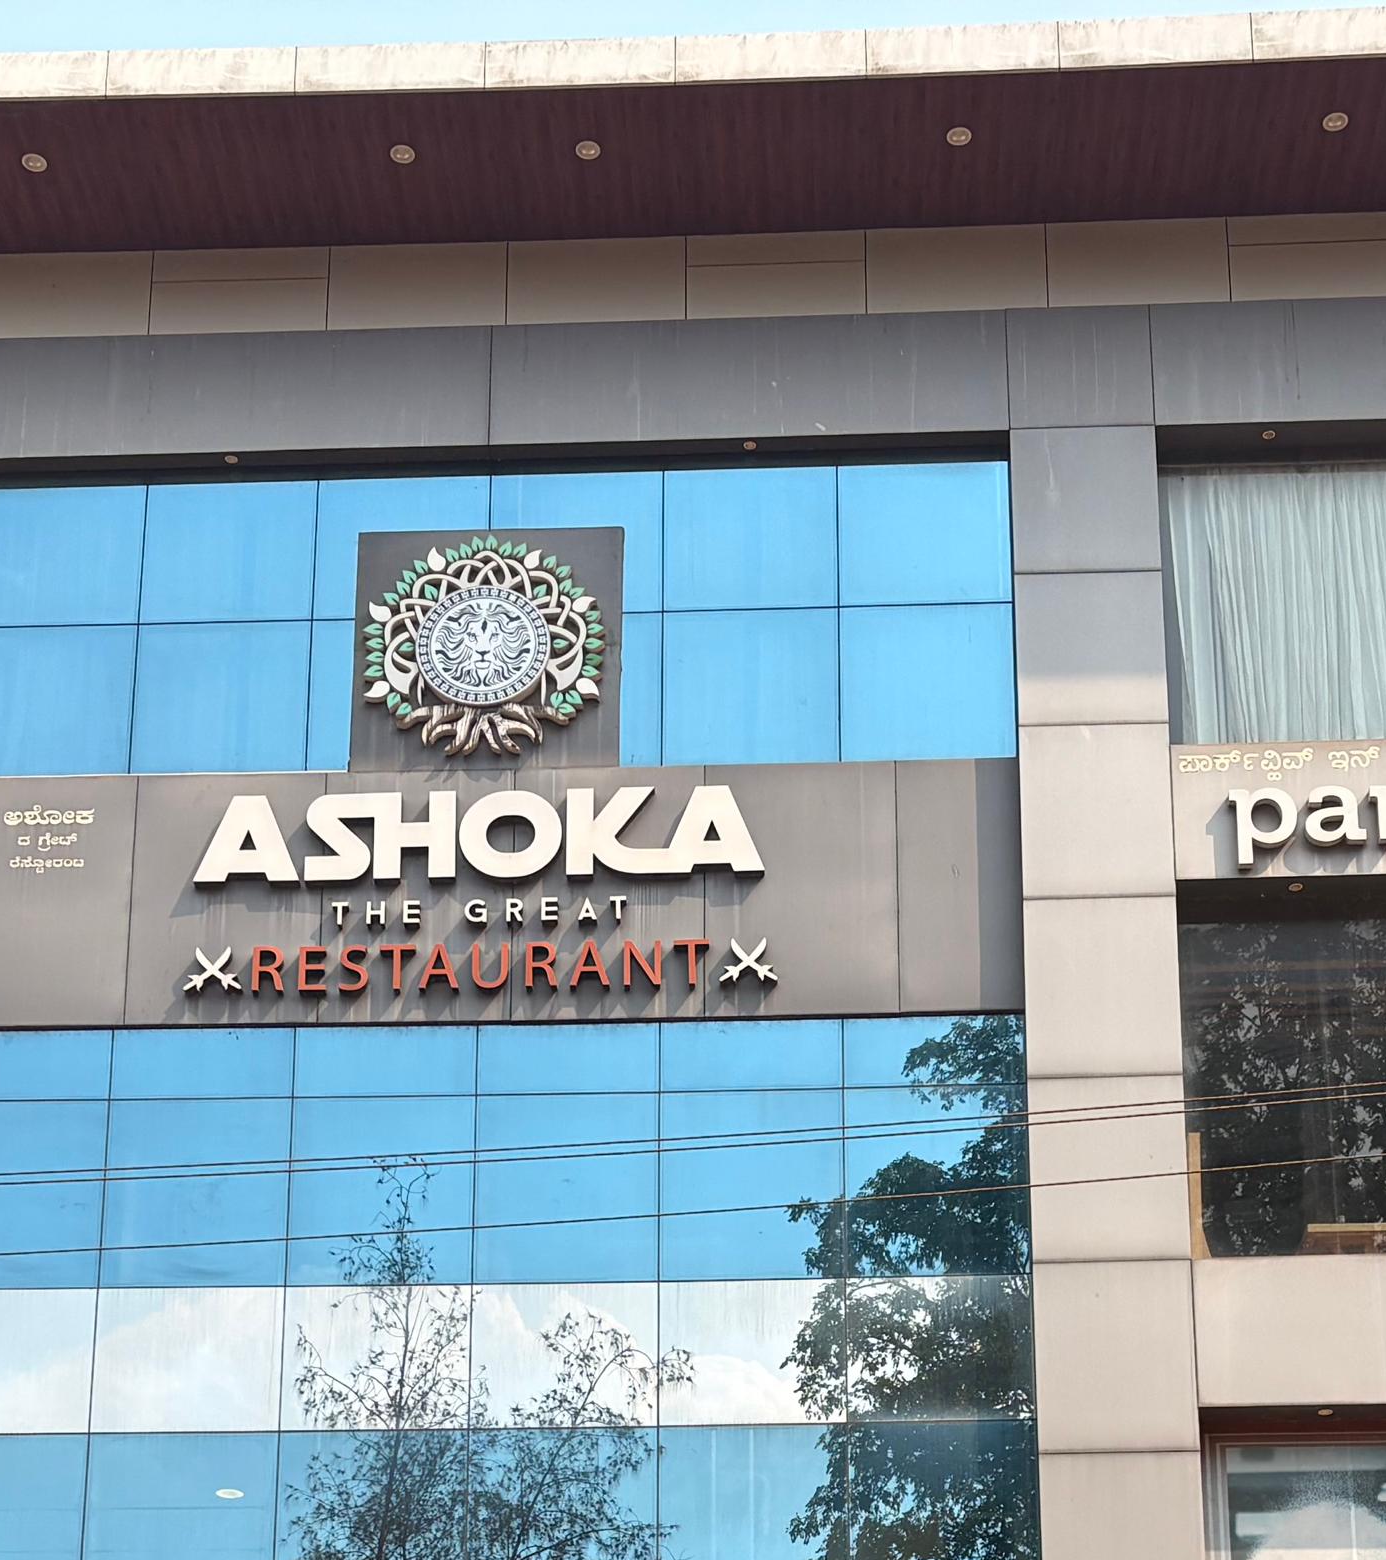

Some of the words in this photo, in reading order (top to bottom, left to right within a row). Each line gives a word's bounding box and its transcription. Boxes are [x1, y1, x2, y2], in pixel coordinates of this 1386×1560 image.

[194, 784, 765, 888] ASHOKA
[333, 901, 422, 928] THE
[465, 894, 629, 923] GREAT
[249, 938, 711, 994] RESTAURANT
